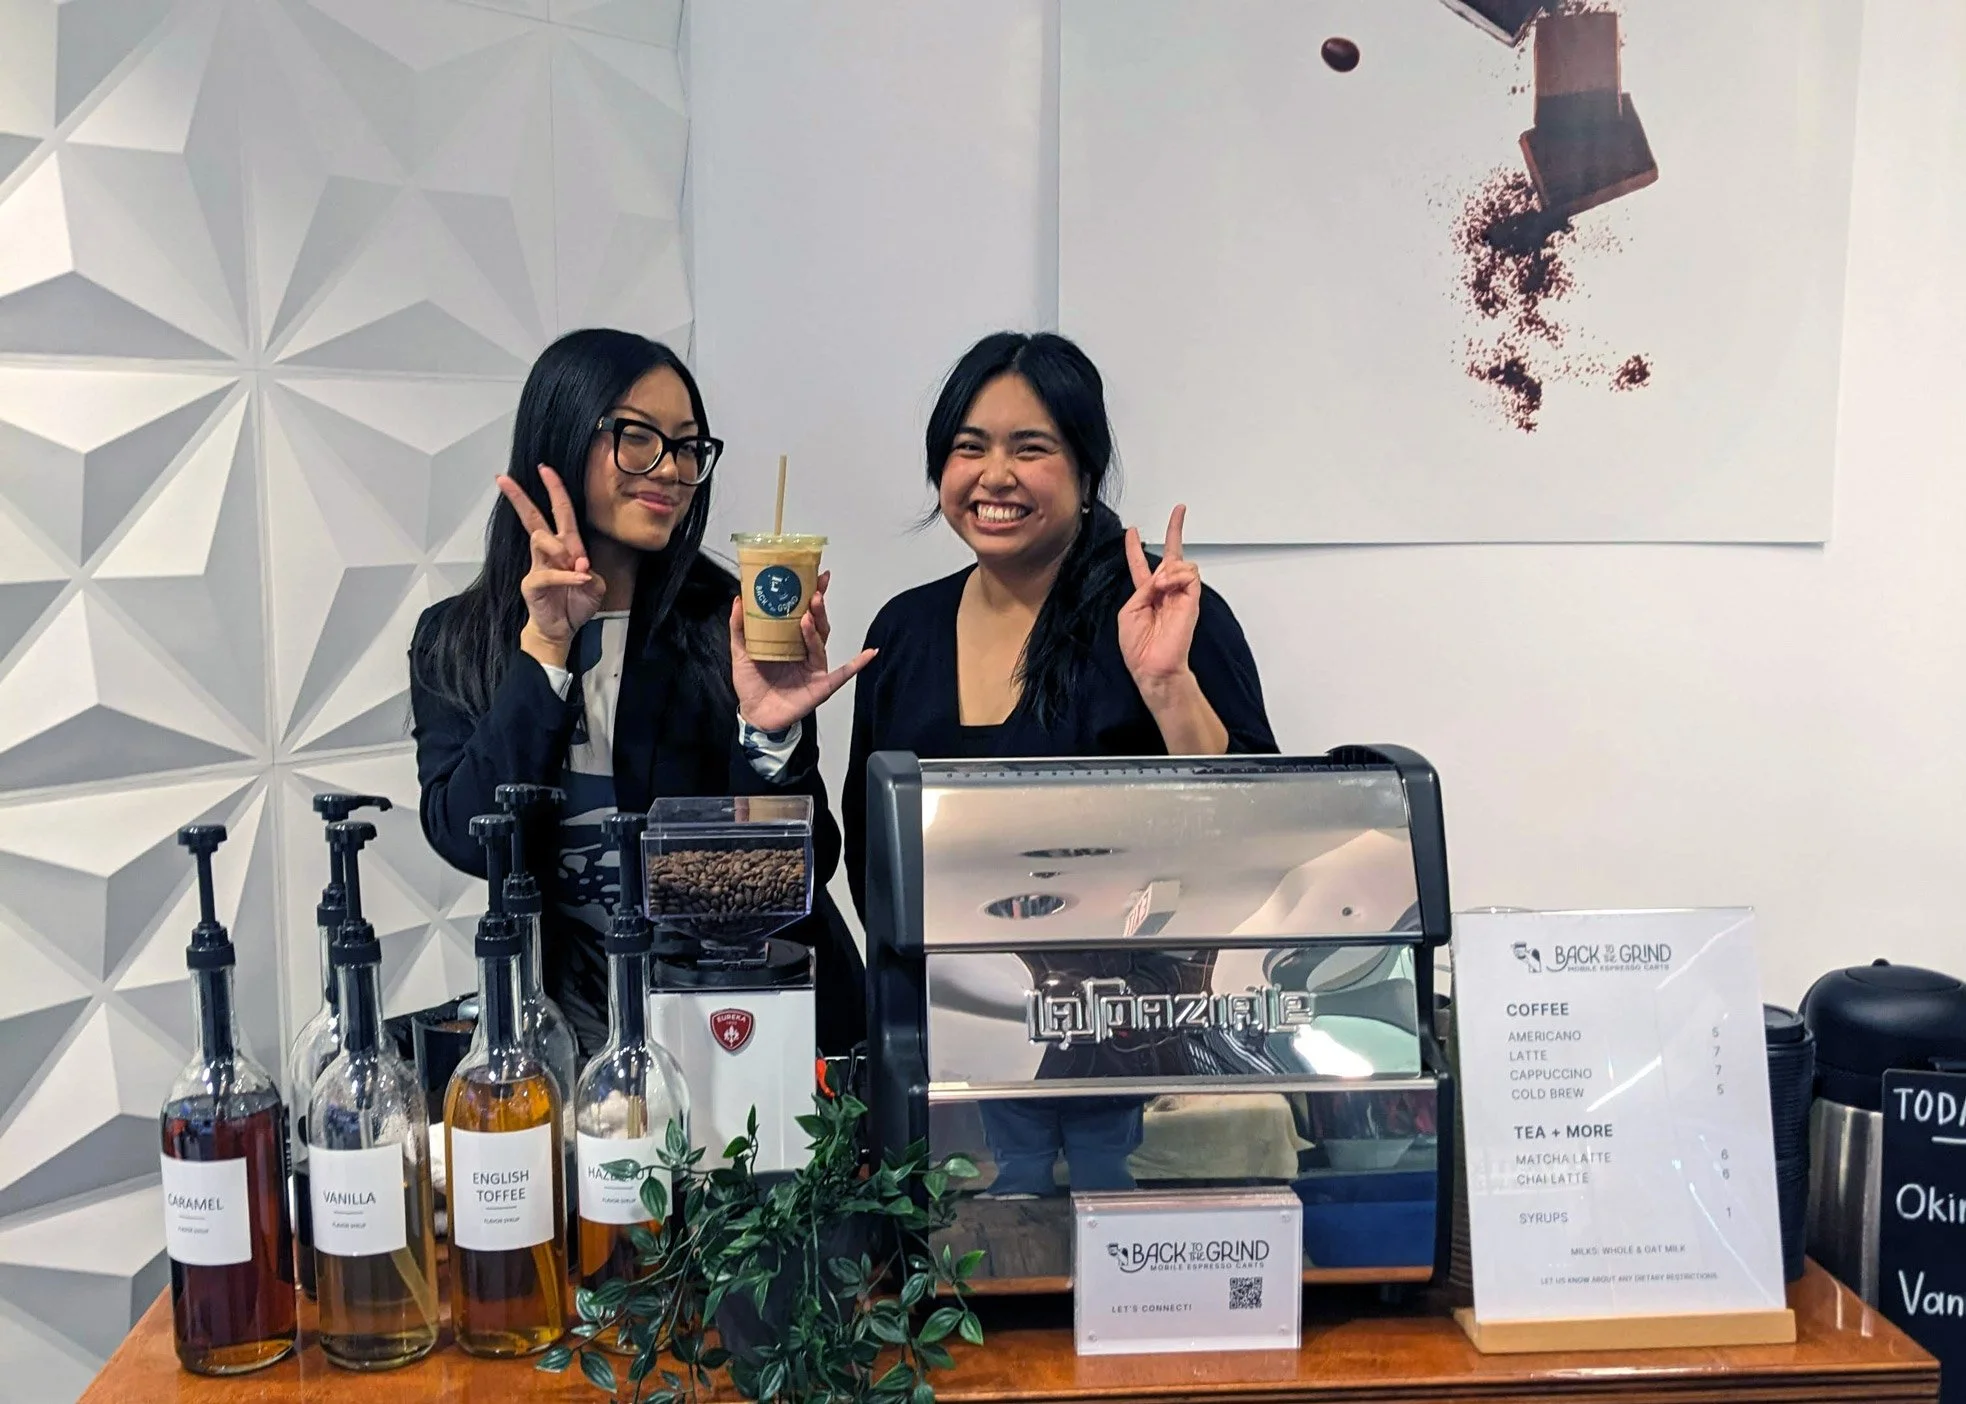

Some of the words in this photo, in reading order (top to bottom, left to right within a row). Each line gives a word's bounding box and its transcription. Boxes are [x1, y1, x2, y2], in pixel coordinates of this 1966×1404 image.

[1546, 944, 1600, 972] BACK
[1619, 943, 1672, 963] GRIND
[1506, 1002, 1569, 1017] COFFEE
[716, 1014, 746, 1023] EUREKA
[1508, 1030, 1581, 1042] AMERICANO
[1509, 1050, 1547, 1061] LATTE
[1713, 1045, 1720, 1057] 7
[1510, 1068, 1592, 1081] CAPPUCCINO
[1715, 1064, 1722, 1076] 7
[1511, 1088, 1546, 1100] COLD
[1550, 1087, 1584, 1099] BREW
[1514, 1125, 1546, 1139] TEA
[1551, 1128, 1561, 1138] +
[1566, 1124, 1613, 1138] MORE
[1516, 1153, 1569, 1165] MATCHA
[1573, 1152, 1611, 1164] LATTE
[1721, 1148, 1729, 1161] 6
[472, 1170, 530, 1185] ENGLISH
[1517, 1173, 1547, 1185] CHAI
[1551, 1172, 1589, 1184] LATTE
[168, 1192, 225, 1211] CARAMEL
[322, 1190, 377, 1205] VANILLA
[476, 1188, 526, 1202] TOFFEE
[1519, 1212, 1568, 1224] SYRUPS
[1120, 1241, 1187, 1273] BACK
[1190, 1242, 1203, 1252] TO
[1206, 1239, 1270, 1263] GRIND
[1602, 1245, 1633, 1255] WHOLE
[1664, 1244, 1686, 1253] MILK
[1567, 1276, 1590, 1284] KNOW
[1111, 1303, 1138, 1313] LET'S
[1141, 1303, 1192, 1313] CONNECT!
